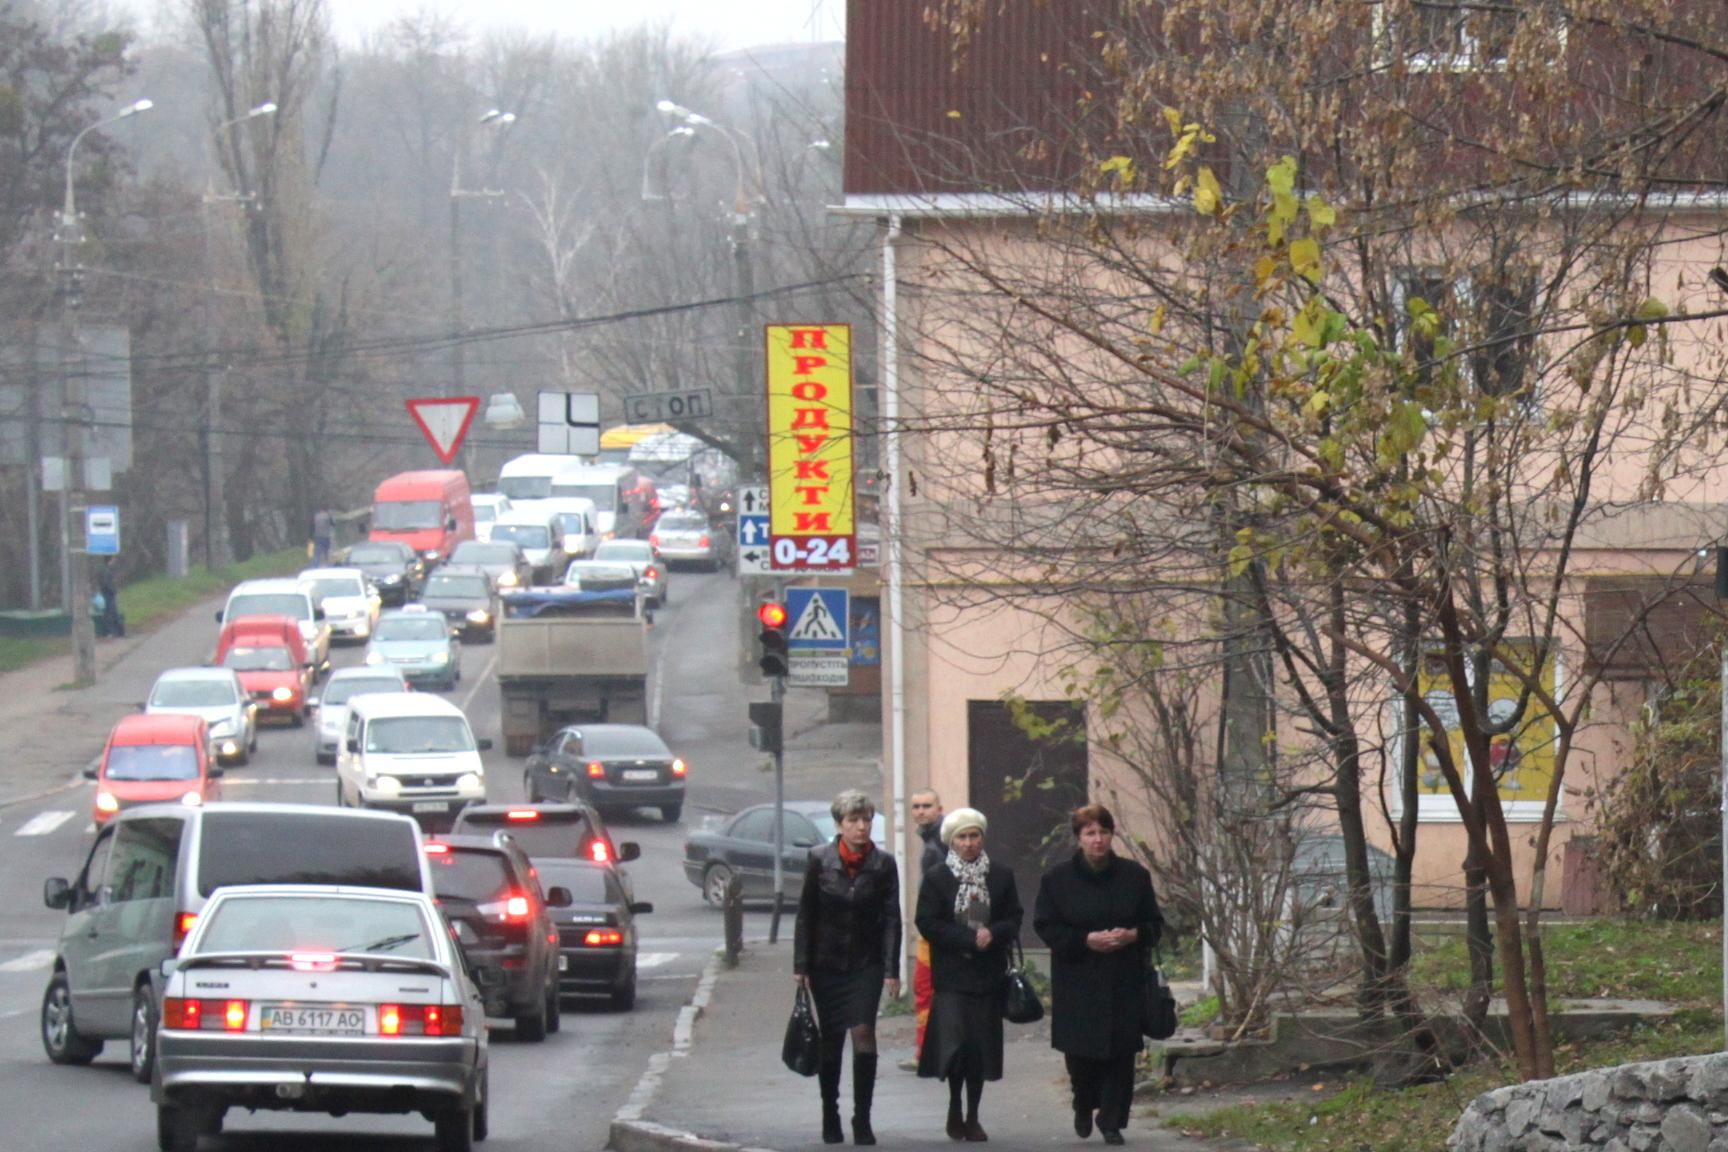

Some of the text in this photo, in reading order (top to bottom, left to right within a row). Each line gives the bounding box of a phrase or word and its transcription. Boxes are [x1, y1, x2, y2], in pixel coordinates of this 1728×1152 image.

[634, 395, 704, 418] СТОП
[790, 329, 832, 531] ПРОДУКТИ
[775, 538, 849, 564] 0-24
[298, 1012, 333, 1027] 6117
